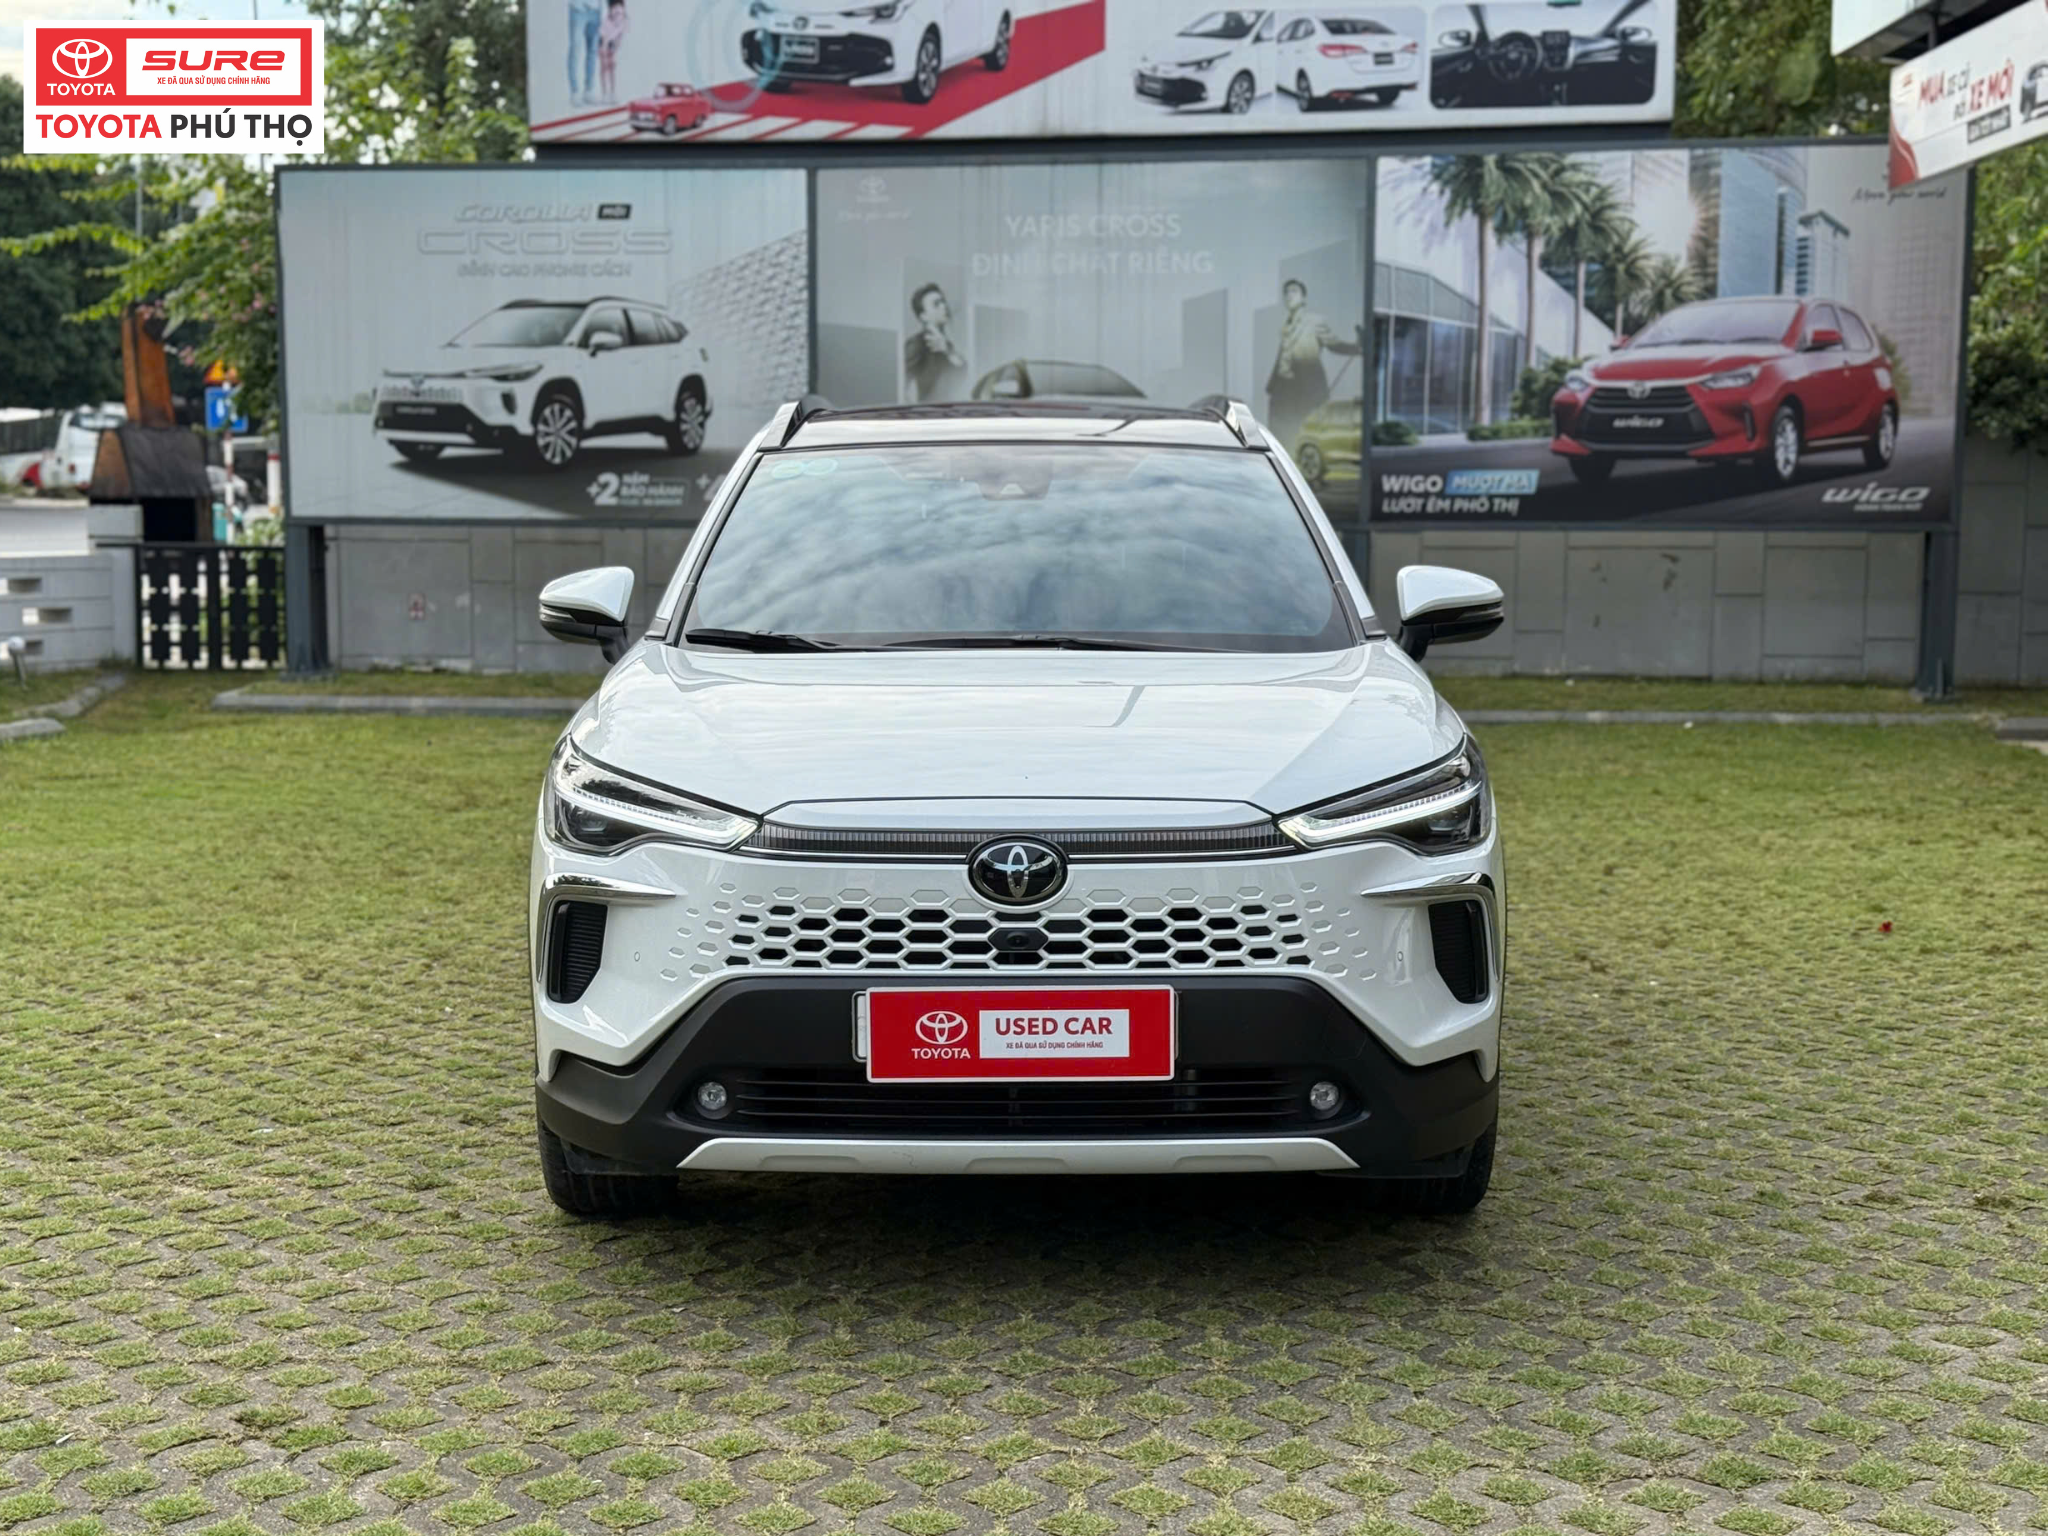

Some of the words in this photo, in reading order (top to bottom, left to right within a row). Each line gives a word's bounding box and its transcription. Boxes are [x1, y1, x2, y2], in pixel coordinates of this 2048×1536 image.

[454, 203, 591, 224] COROLLA
[1004, 213, 1082, 238] YARIS
[1088, 213, 1182, 238] CROSS
[418, 229, 674, 255] CROSS
[1381, 474, 1443, 493] WIGO
[995, 1017, 1058, 1036] USED
[1064, 1016, 1113, 1035] CAR
[911, 1047, 971, 1060] TOYOTA
